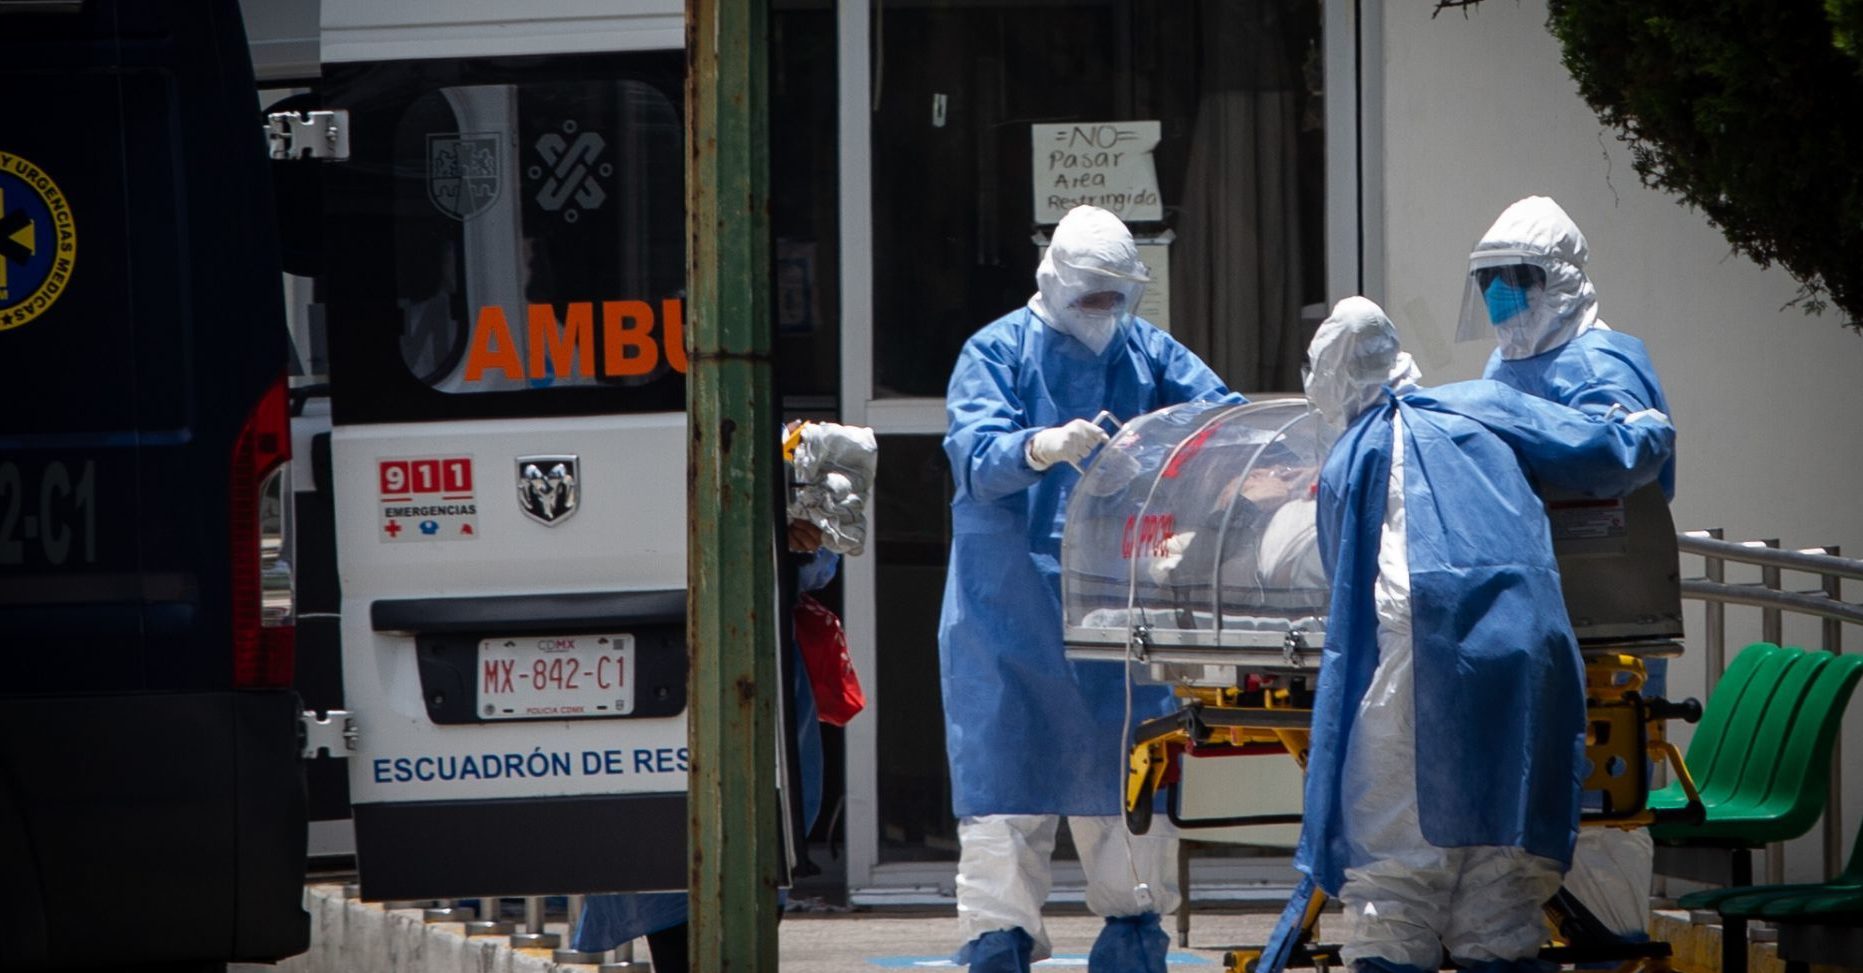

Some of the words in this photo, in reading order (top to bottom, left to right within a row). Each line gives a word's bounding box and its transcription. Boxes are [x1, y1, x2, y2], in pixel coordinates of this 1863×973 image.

[1049, 150, 1126, 170] Pasar
[1053, 172, 1106, 189] Area
[15, 160, 73, 253] URGENCIAS
[1047, 187, 1158, 211] Restringida
[13, 257, 71, 321] MEDICAS
[385, 463, 465, 491] 911
[384, 504, 477, 518] EMERGENCIAS
[537, 639, 577, 651] CDMX
[483, 655, 625, 694] MX-842-C1
[373, 746, 572, 784] ESCUADRÓN
[582, 749, 624, 776] DE
[633, 747, 689, 774] RES
